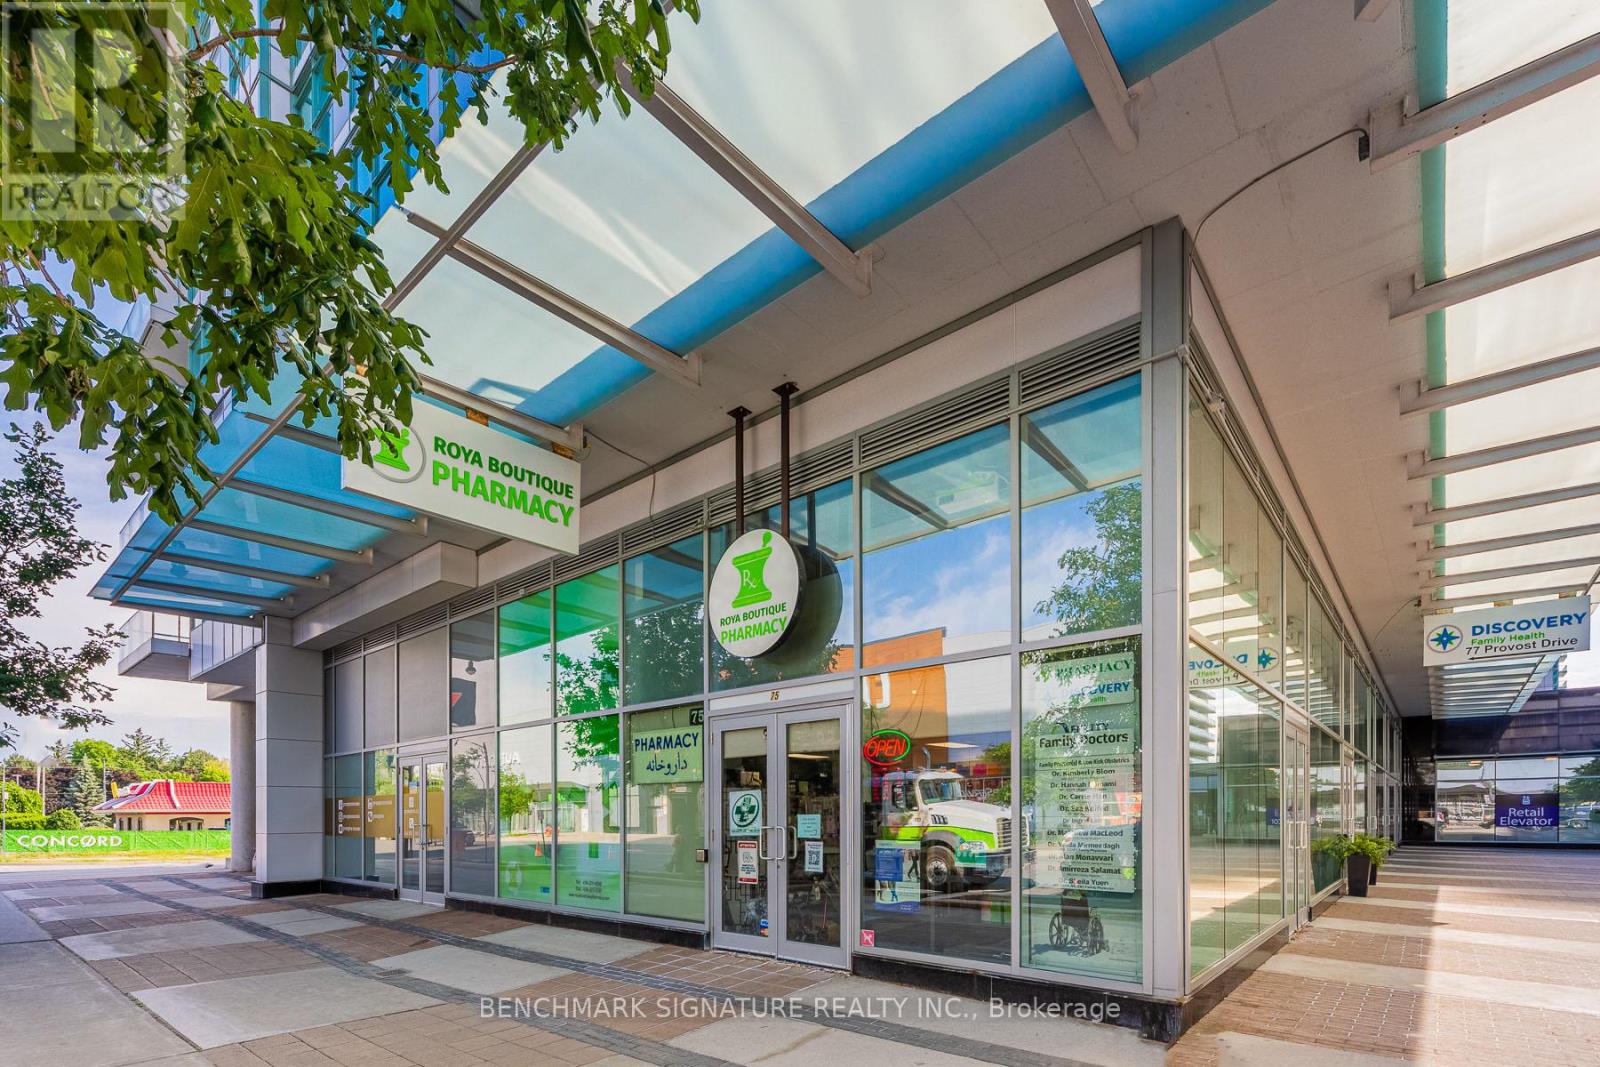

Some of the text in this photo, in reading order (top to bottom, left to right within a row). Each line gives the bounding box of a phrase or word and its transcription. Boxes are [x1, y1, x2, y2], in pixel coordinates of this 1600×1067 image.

[434, 436, 574, 499] ROYA BOUTIQUE
[432, 460, 575, 527] PHARMACY
[720, 602, 787, 627] ROYA BOUTIQUE
[1471, 612, 1588, 636] DISCOVERY
[720, 616, 788, 644] PHARMACY
[1471, 632, 1546, 646] Family Health
[1466, 637, 1578, 656] 77 Provost Drive
[770, 690, 780, 701] 75
[690, 710, 704, 724] 75
[634, 732, 699, 752] PHARMACY
[866, 738, 906, 758] OPEN
[1039, 732, 1129, 750] Family Doctors
[646, 752, 688, 776] داروخانه
[1500, 816, 1553, 826] Elevator
[1508, 806, 1544, 818] Retail
